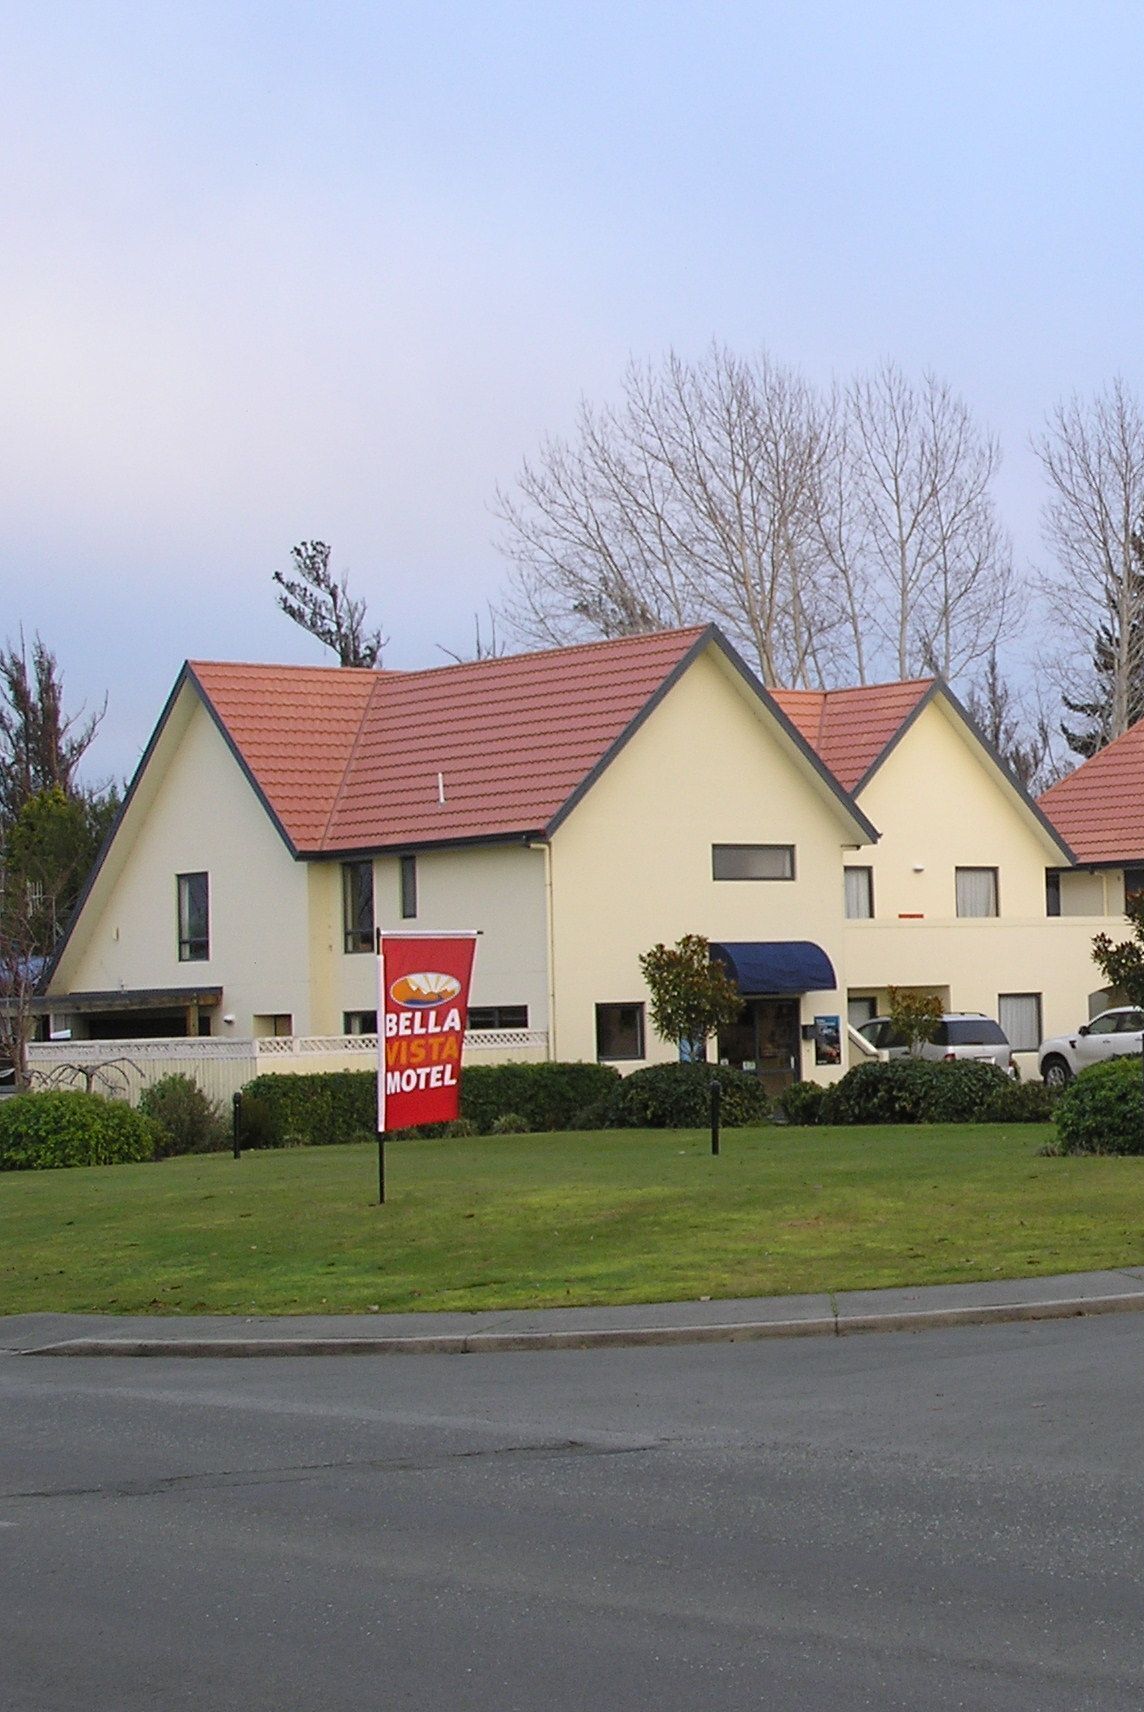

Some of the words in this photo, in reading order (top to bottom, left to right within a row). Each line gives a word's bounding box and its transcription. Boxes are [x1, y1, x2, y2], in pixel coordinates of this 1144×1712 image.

[386, 1008, 461, 1037] BELLA
[386, 1036, 459, 1066] VISTA
[387, 1064, 457, 1095] MOTEL
